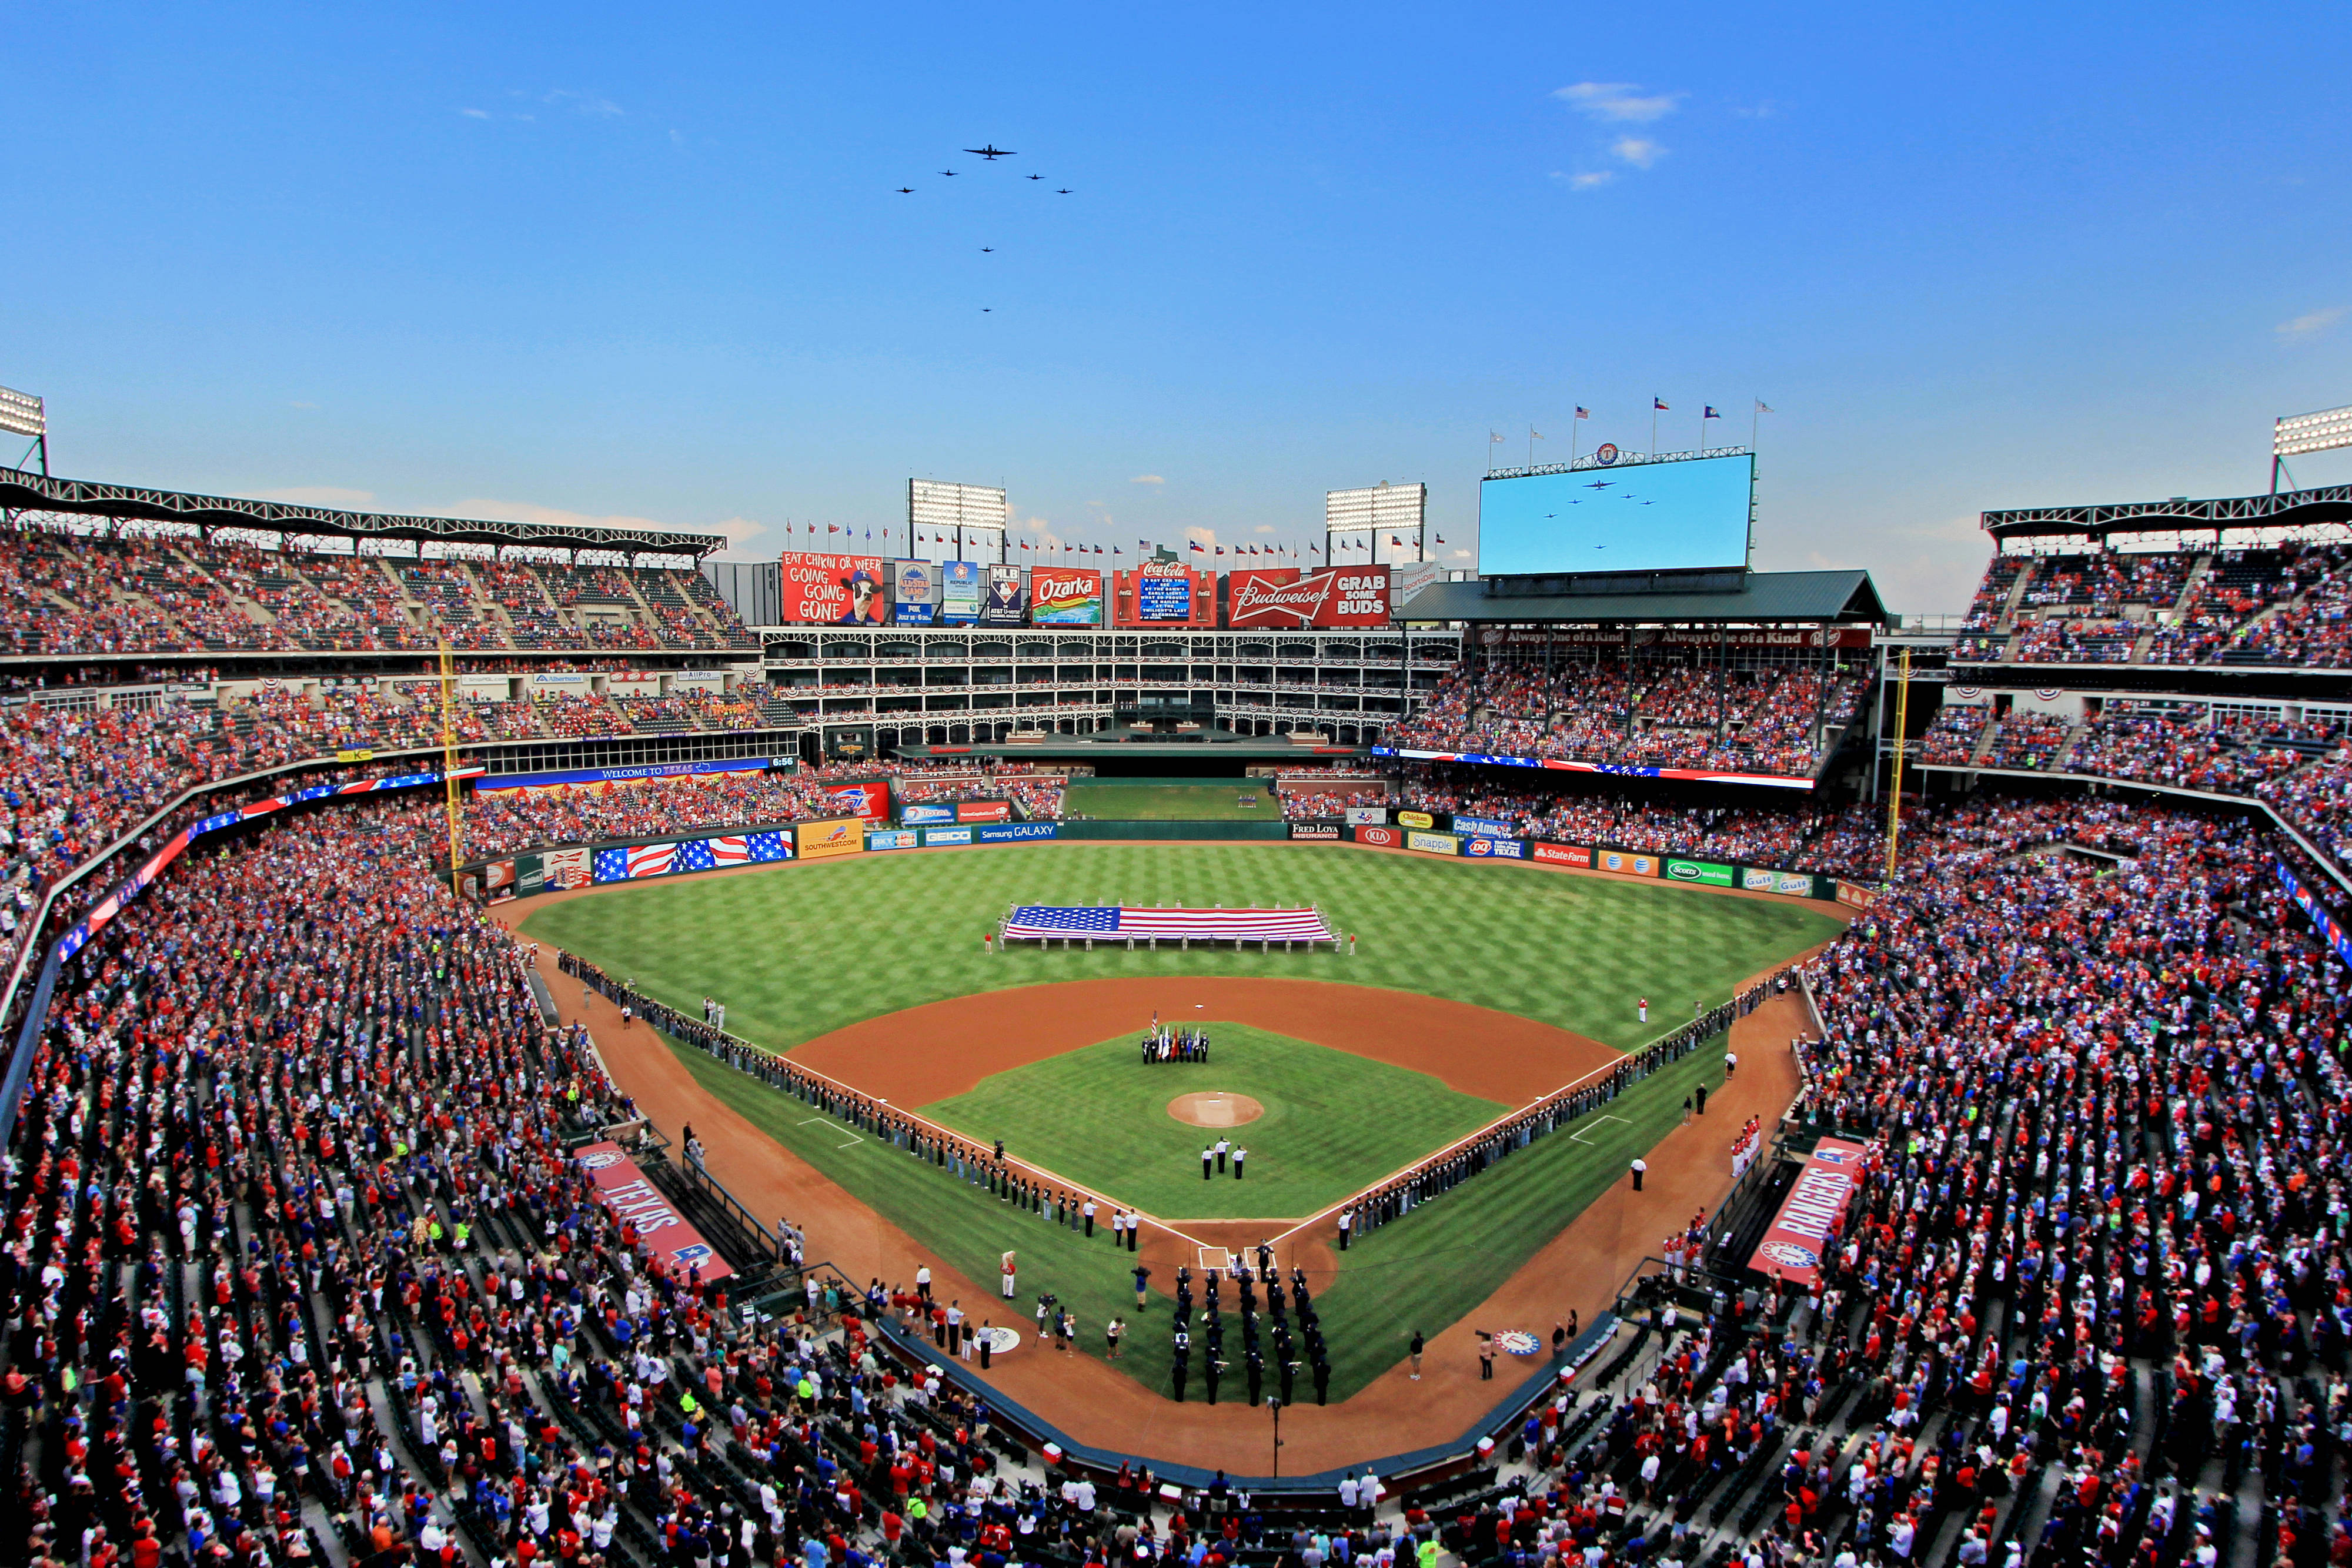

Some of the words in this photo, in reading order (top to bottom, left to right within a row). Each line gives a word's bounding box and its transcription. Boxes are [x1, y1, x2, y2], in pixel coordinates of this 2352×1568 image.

[1603, 450, 1611, 459] T
[784, 553, 803, 565] EAT
[806, 554, 836, 569] CHIKIN
[839, 556, 853, 571] OR
[854, 559, 881, 572] WEER
[790, 567, 830, 584] GOING
[993, 568, 1018, 579] MLB
[1337, 575, 1386, 591] GRAB
[1403, 572, 1435, 591] SportsDay
[804, 584, 846, 601] GOING
[1040, 577, 1093, 601] Ozarka
[1345, 590, 1377, 600] SOME
[1234, 586, 1330, 607] Budweiser
[800, 600, 841, 620] GONE
[1337, 600, 1385, 615] BUDS
[1507, 632, 1547, 644] Always
[1551, 633, 1570, 642] One
[1573, 632, 1586, 641] of
[1594, 632, 1624, 642] Kind
[1662, 631, 1709, 644] Always
[1740, 631, 1755, 643] of
[1756, 634, 1763, 643] a
[1766, 631, 1801, 643] Kind
[773, 757, 793, 767] 6:56
[602, 768, 647, 778] WELCOME
[663, 764, 693, 774] TEXAS
[1014, 825, 1054, 837] GALAXY
[1293, 824, 1315, 833] FRED
[1317, 824, 1338, 833] LOYA
[926, 831, 970, 842] GEICO
[1369, 831, 1386, 841] KIA
[804, 840, 857, 851] SOUTHWEST.COM
[1413, 835, 1452, 851] Snapple
[1546, 849, 1589, 862] StateFarm
[1673, 865, 1696, 875] Scotts
[1716, 872, 1731, 880] here.
[1746, 875, 1772, 885] Gulf
[1780, 880, 1807, 890] Gulf
[603, 1178, 680, 1234] TEXAS
[1777, 1167, 1852, 1239] RANGERS
